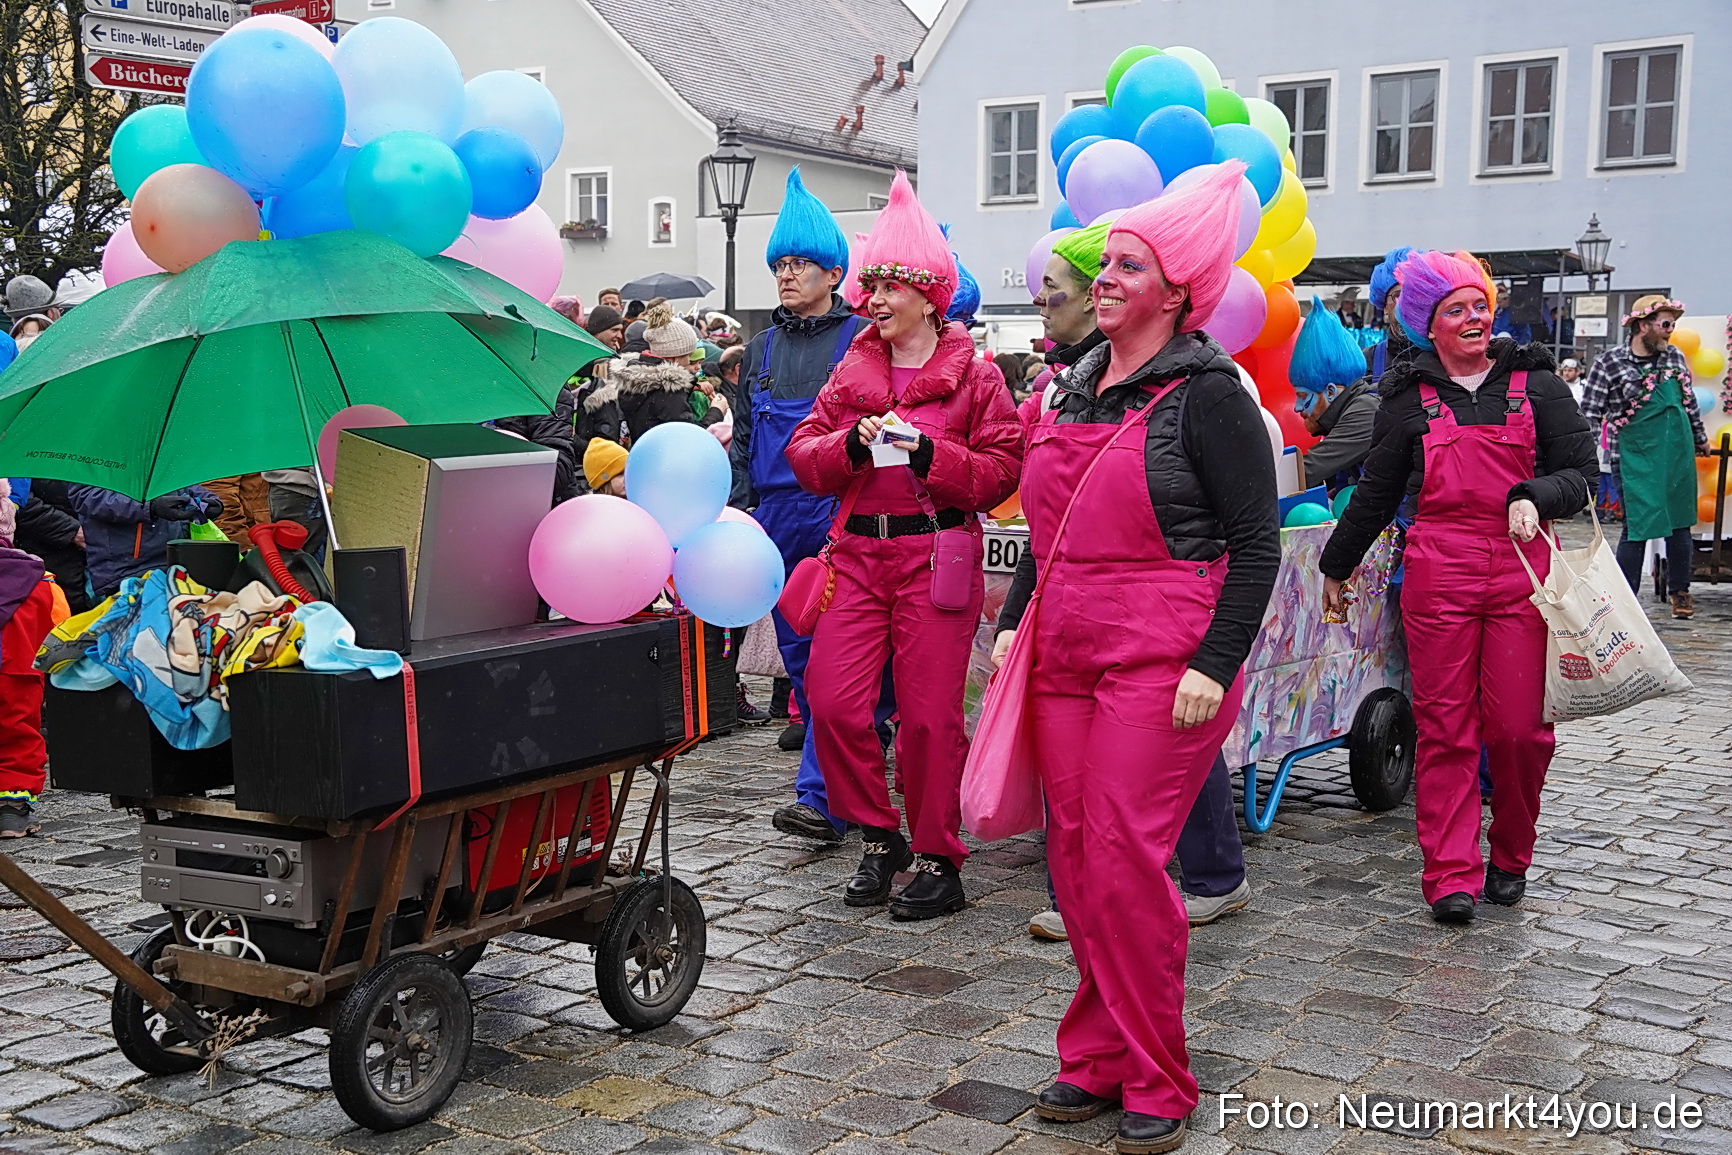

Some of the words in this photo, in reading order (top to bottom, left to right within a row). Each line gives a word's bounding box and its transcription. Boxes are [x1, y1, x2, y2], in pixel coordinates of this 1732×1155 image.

[147, 0, 230, 23] Europahalle
[110, 28, 206, 53] Eine-Welt-Laden
[988, 538, 1028, 568] BO
[1597, 640, 1636, 676] Apotheke
[683, 657, 692, 716] strauss
[1600, 687, 1617, 697] Bernd
